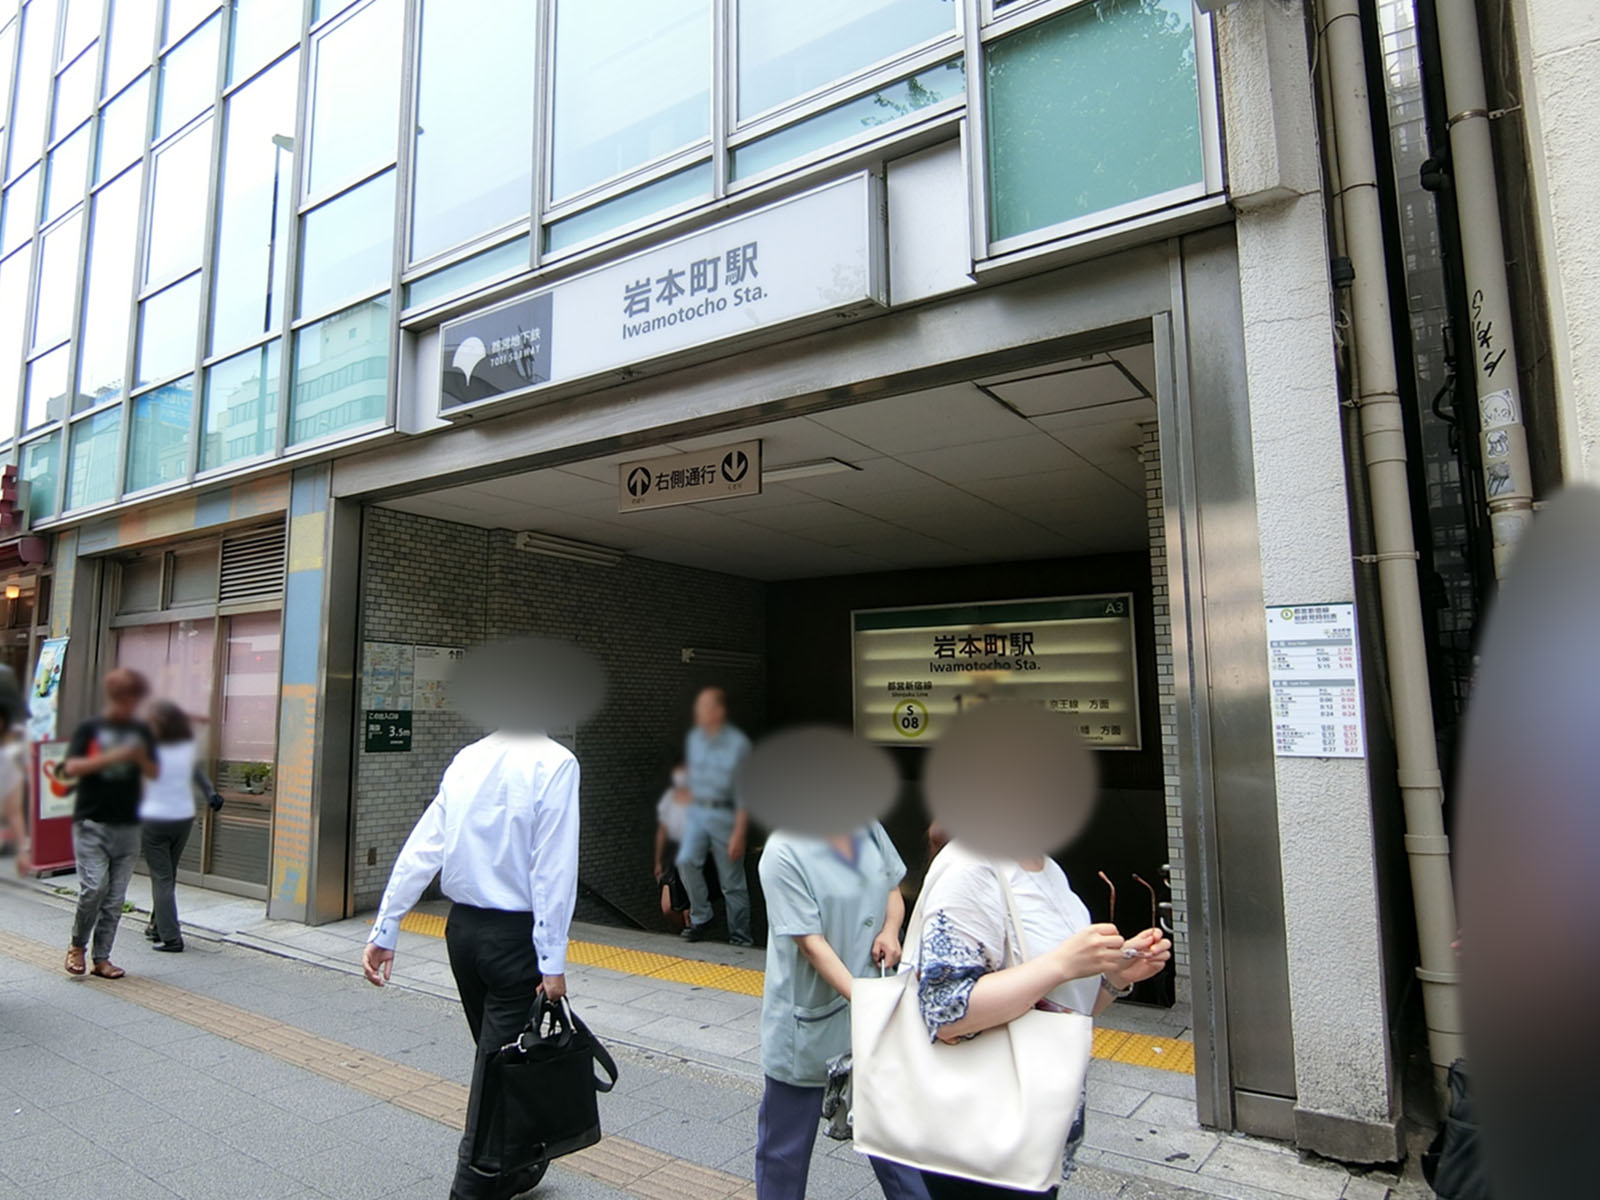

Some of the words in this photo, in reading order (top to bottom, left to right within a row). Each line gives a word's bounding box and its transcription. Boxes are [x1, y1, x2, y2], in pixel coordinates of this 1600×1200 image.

[623, 241, 758, 318] 岩本町駅
[622, 297, 727, 340] Iwamotocho
[733, 285, 768, 307] Sta.
[655, 464, 717, 491] 右側通行
[1105, 602, 1124, 614] A3
[933, 632, 1035, 659] 岩本町駅
[930, 660, 1011, 673] Iwamotocho
[1015, 659, 1041, 671] Sta.
[907, 705, 914, 716] S
[901, 717, 919, 729] 08
